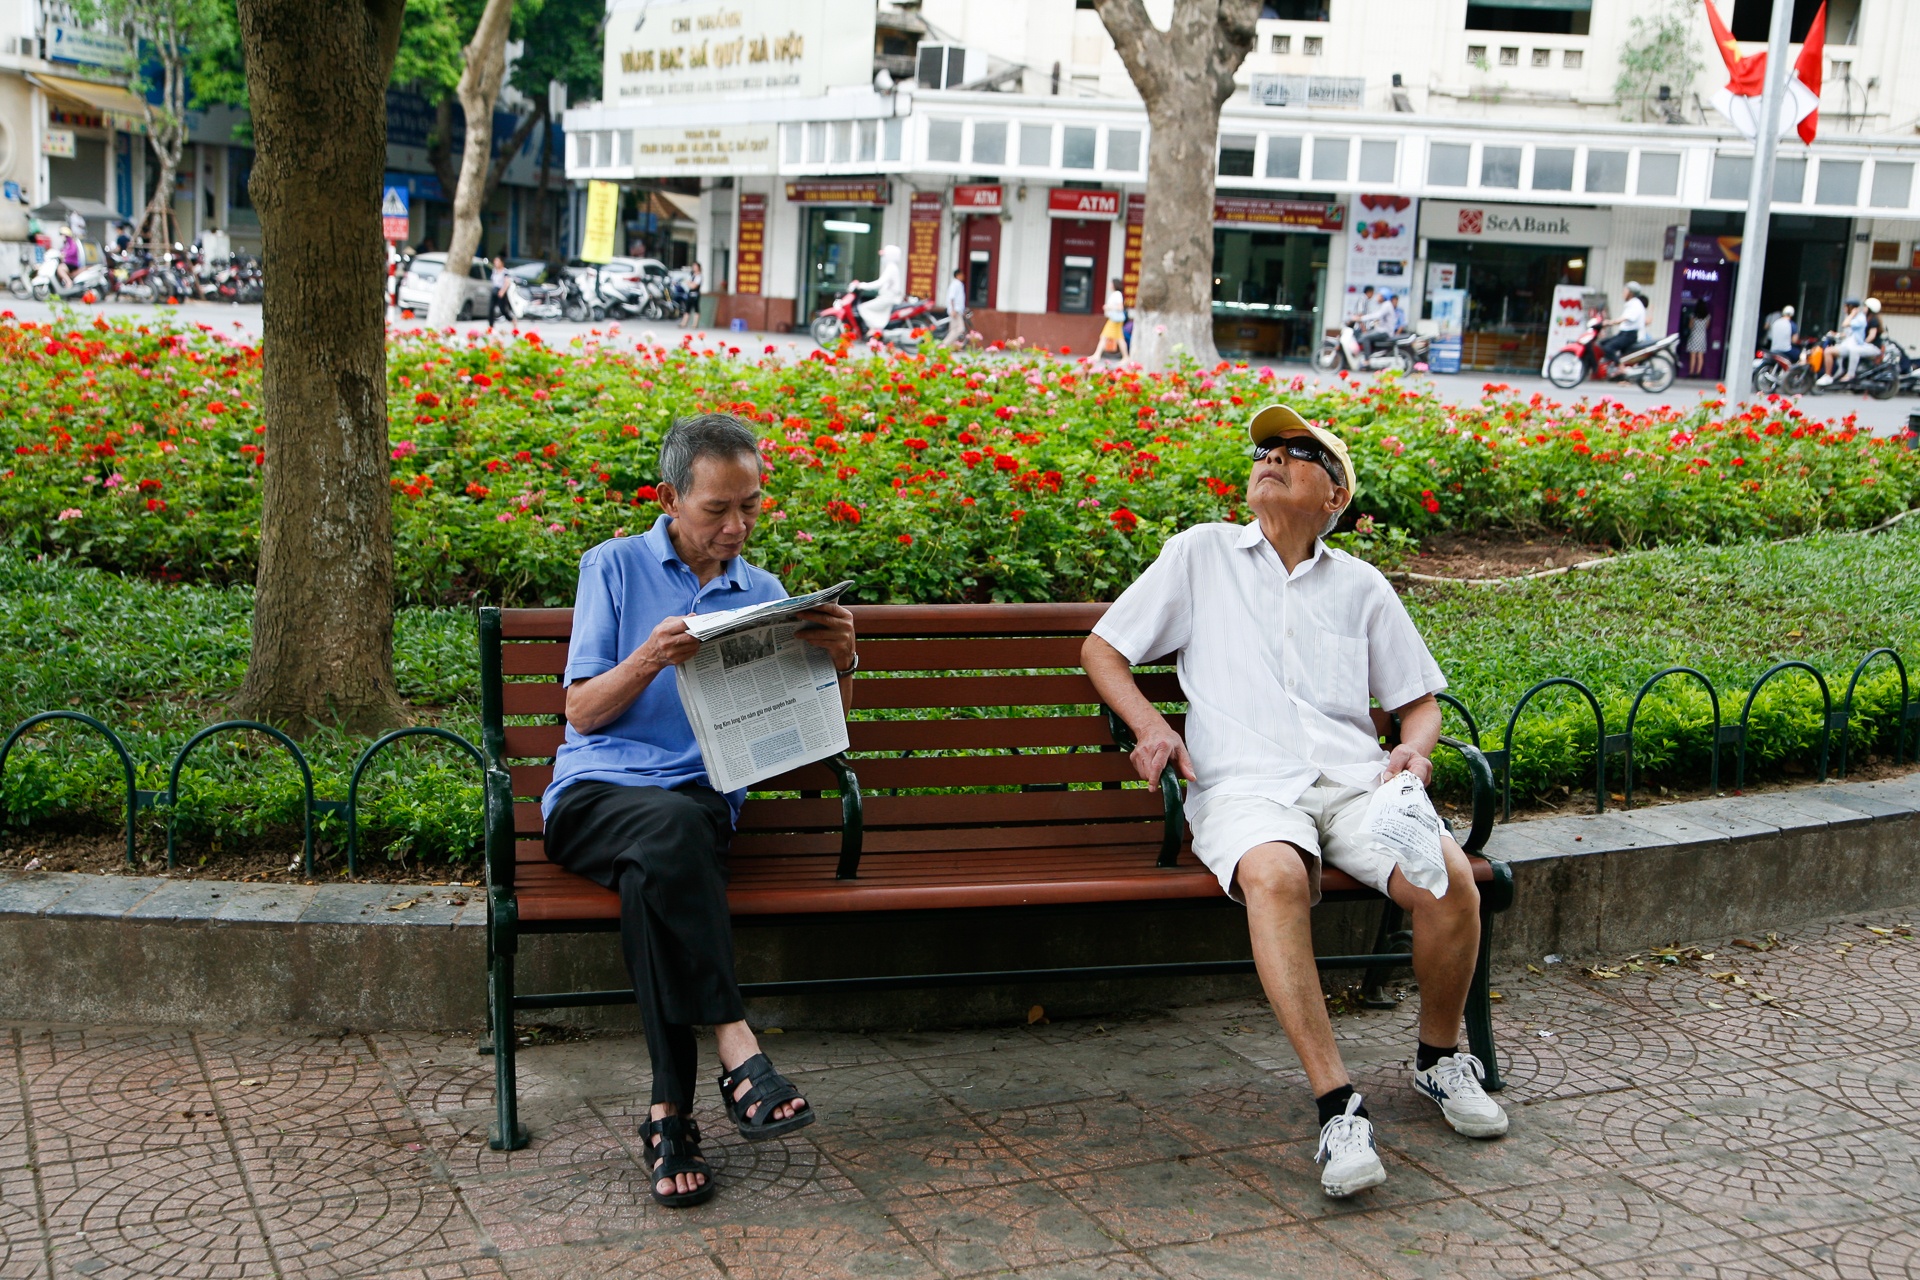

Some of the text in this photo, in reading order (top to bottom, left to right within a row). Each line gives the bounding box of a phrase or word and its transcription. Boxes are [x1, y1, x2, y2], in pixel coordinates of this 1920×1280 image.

[973, 190, 998, 205] ATM
[1077, 195, 1116, 212] ATM
[1486, 213, 1571, 235] SeABank
